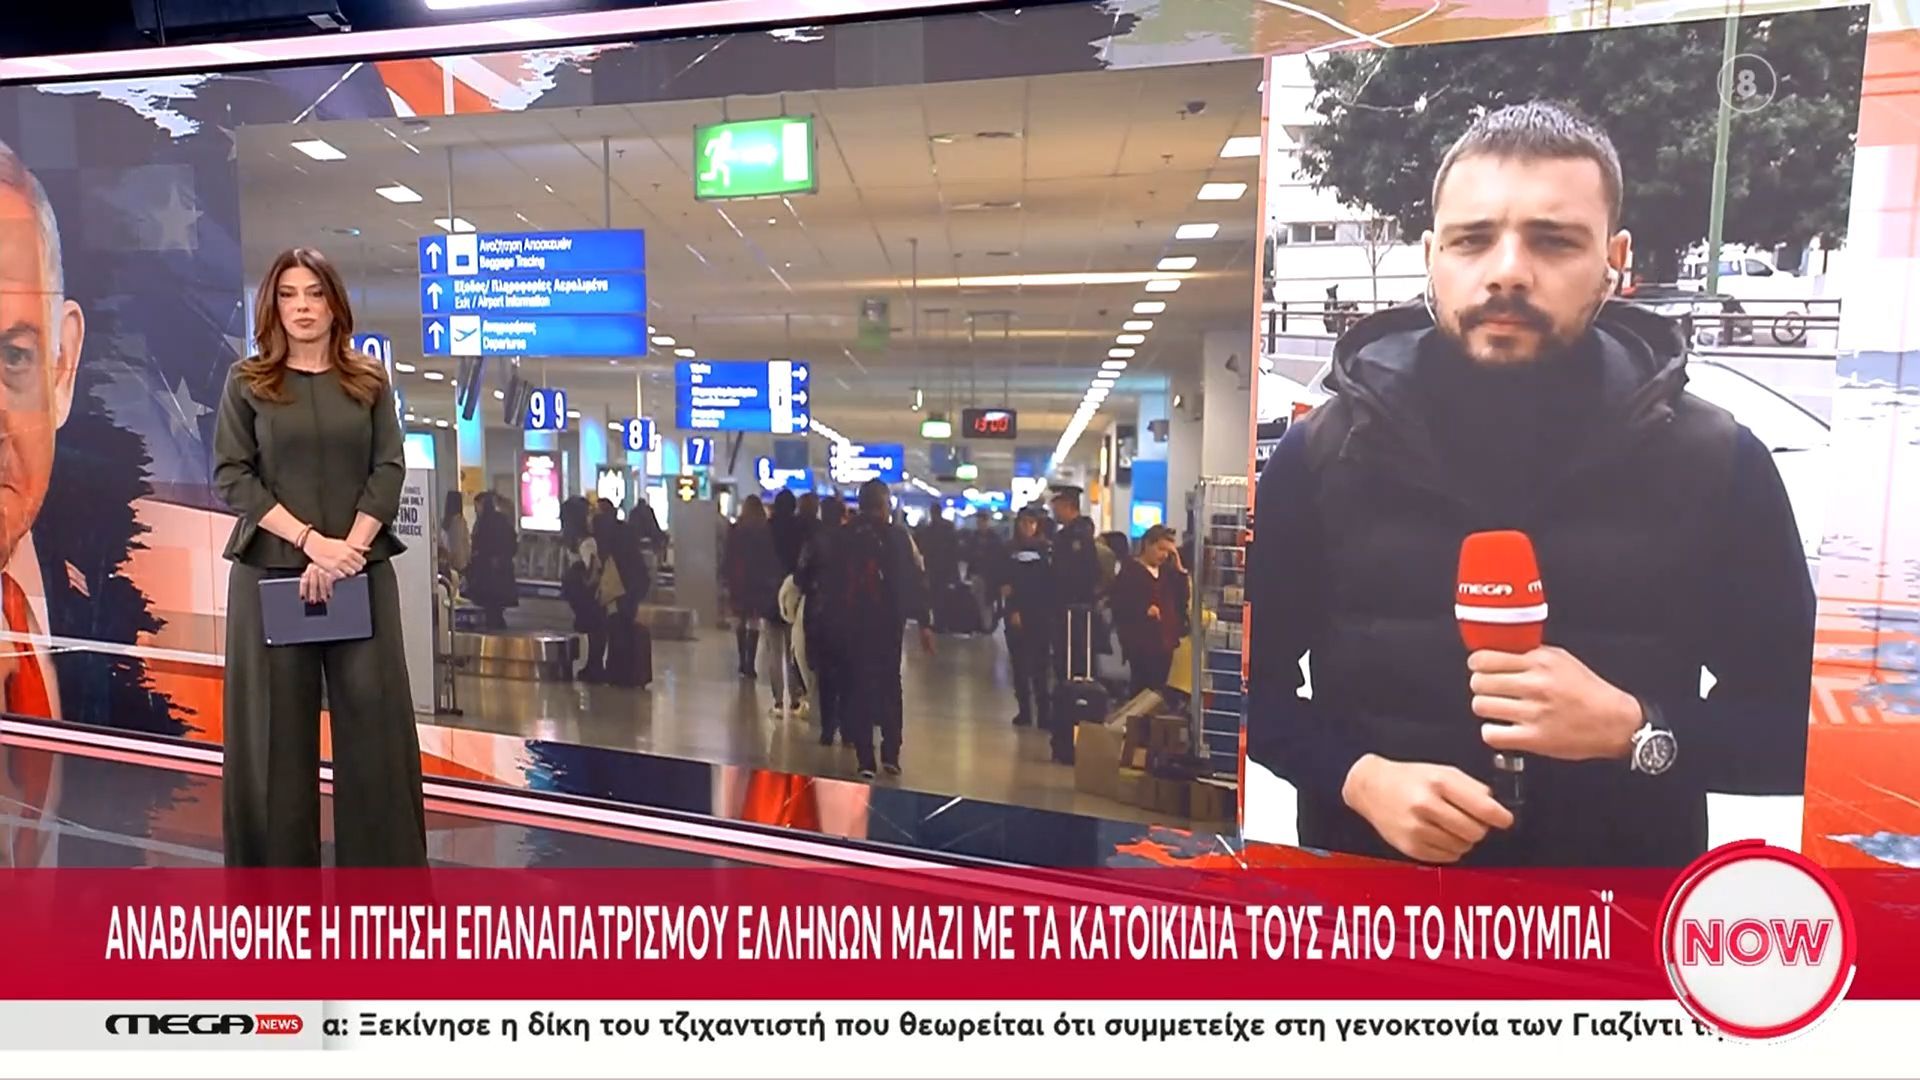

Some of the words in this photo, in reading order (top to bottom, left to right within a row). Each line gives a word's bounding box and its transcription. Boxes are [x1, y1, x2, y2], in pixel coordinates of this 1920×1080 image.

[530, 391, 545, 429] 9
[628, 419, 643, 450] 8
[692, 438, 705, 465] 7
[1458, 582, 1513, 596] MEGA
